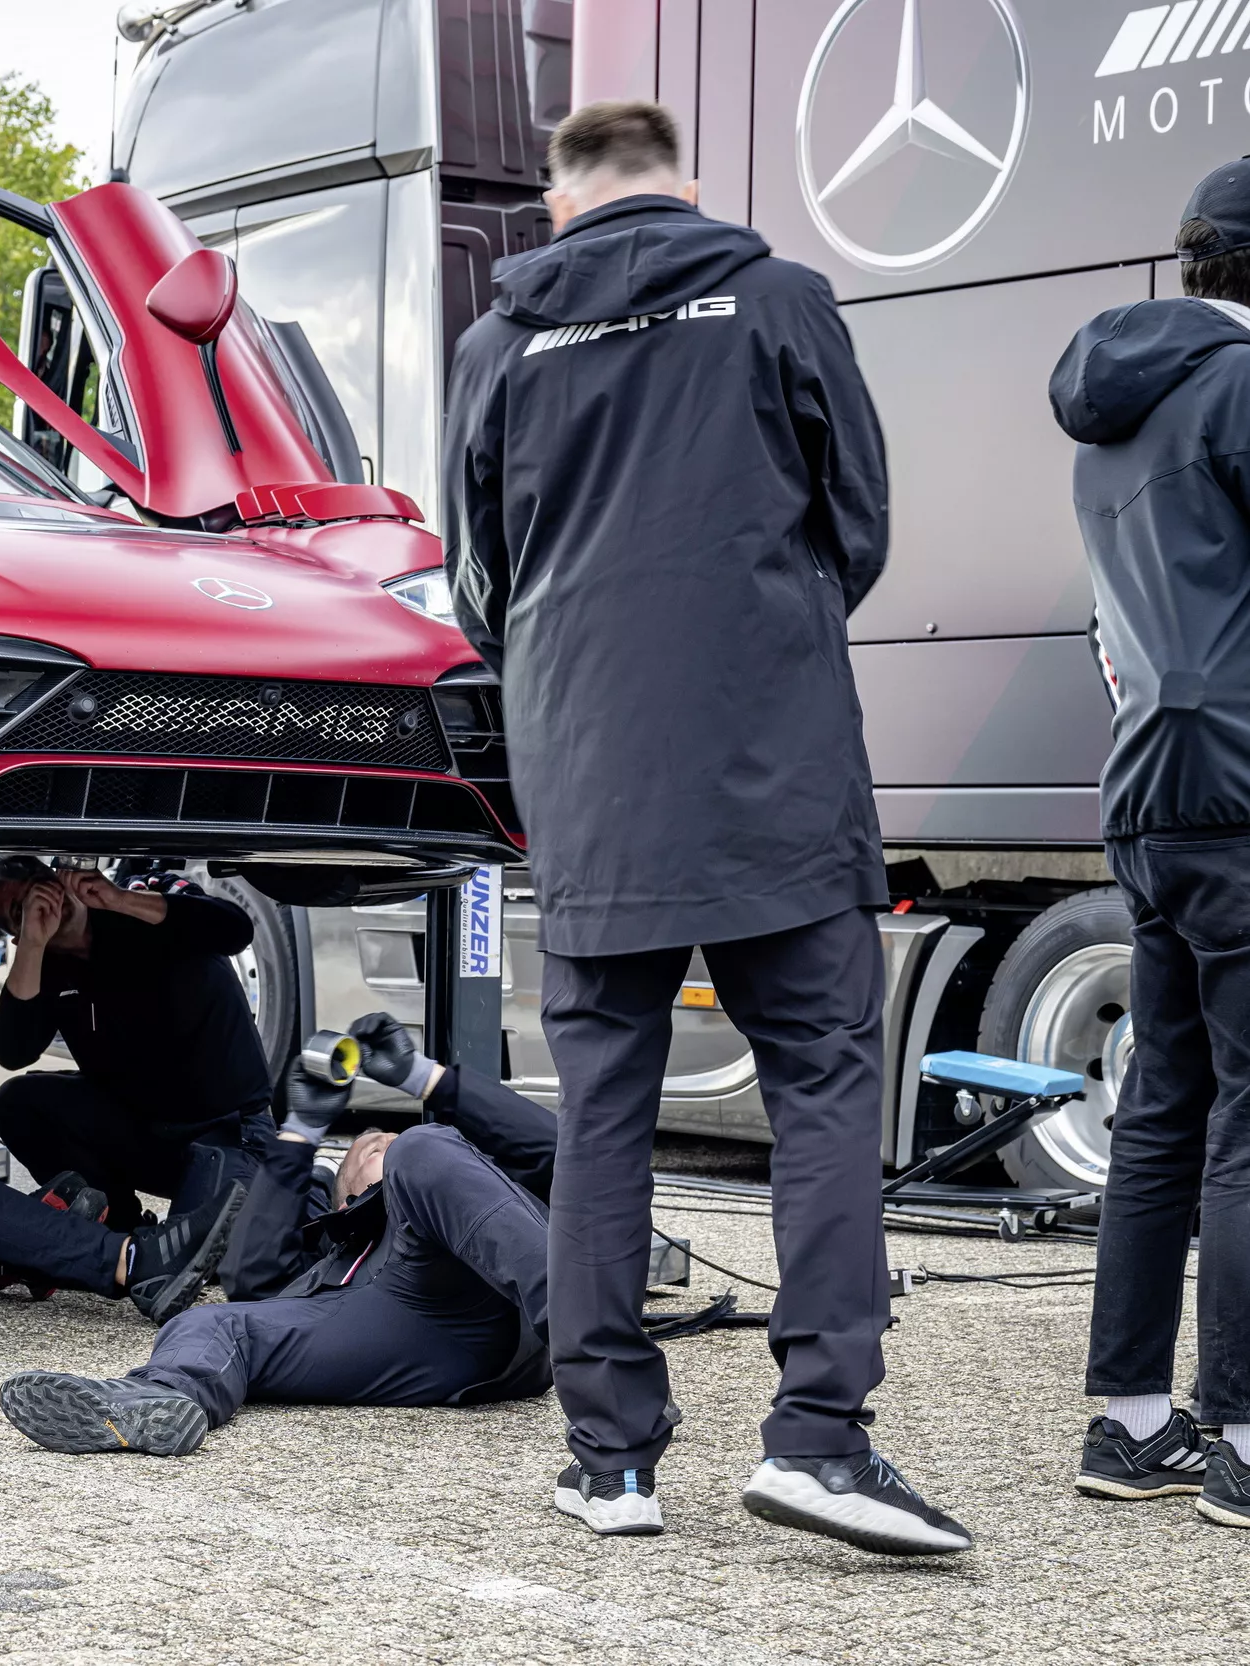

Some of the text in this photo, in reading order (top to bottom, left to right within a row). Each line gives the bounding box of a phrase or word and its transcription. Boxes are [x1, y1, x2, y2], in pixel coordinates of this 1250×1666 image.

[1093, 77, 1250, 144] MOT
[196, 698, 393, 743] AMG
[470, 867, 490, 976] UNZER
